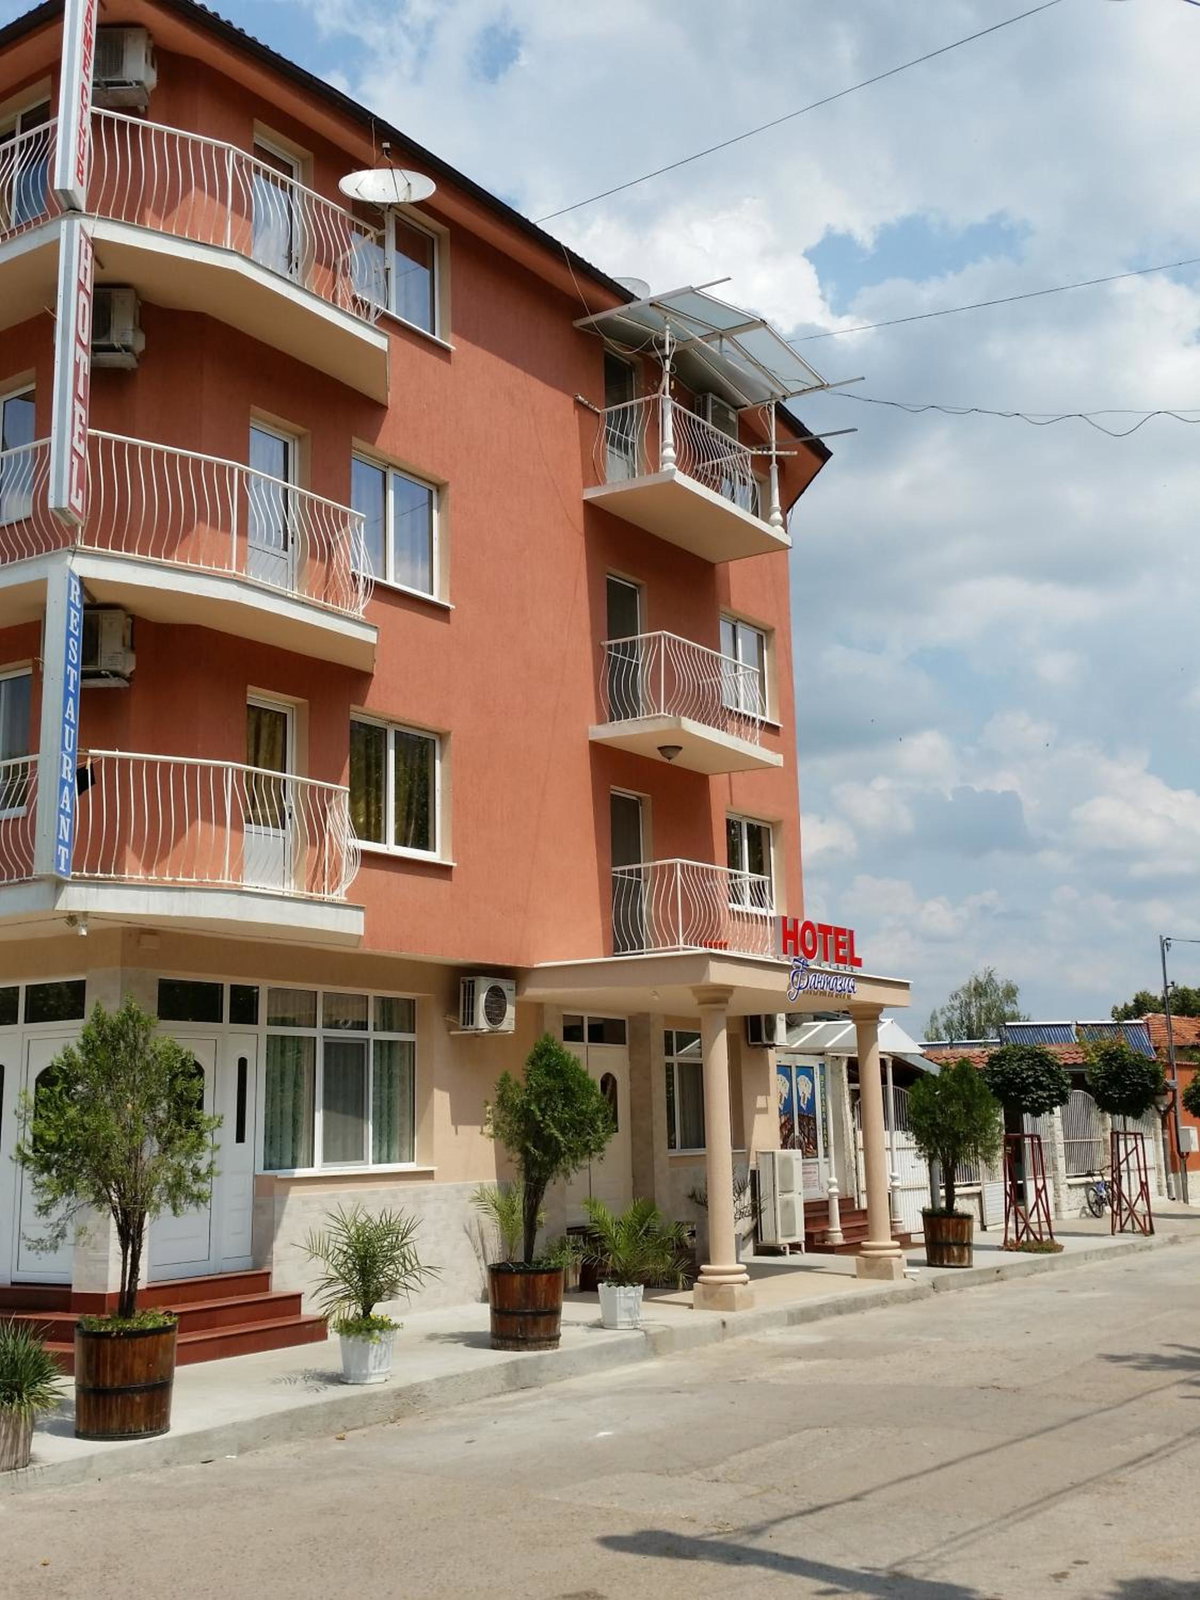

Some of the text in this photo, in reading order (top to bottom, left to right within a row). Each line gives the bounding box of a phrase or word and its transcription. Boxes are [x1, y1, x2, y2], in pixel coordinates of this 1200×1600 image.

[76, 82, 90, 187] CLUB
[70, 237, 94, 514] HOTEL
[57, 576, 82, 873] RESTAURANT
[781, 915, 863, 968] HOTEL
